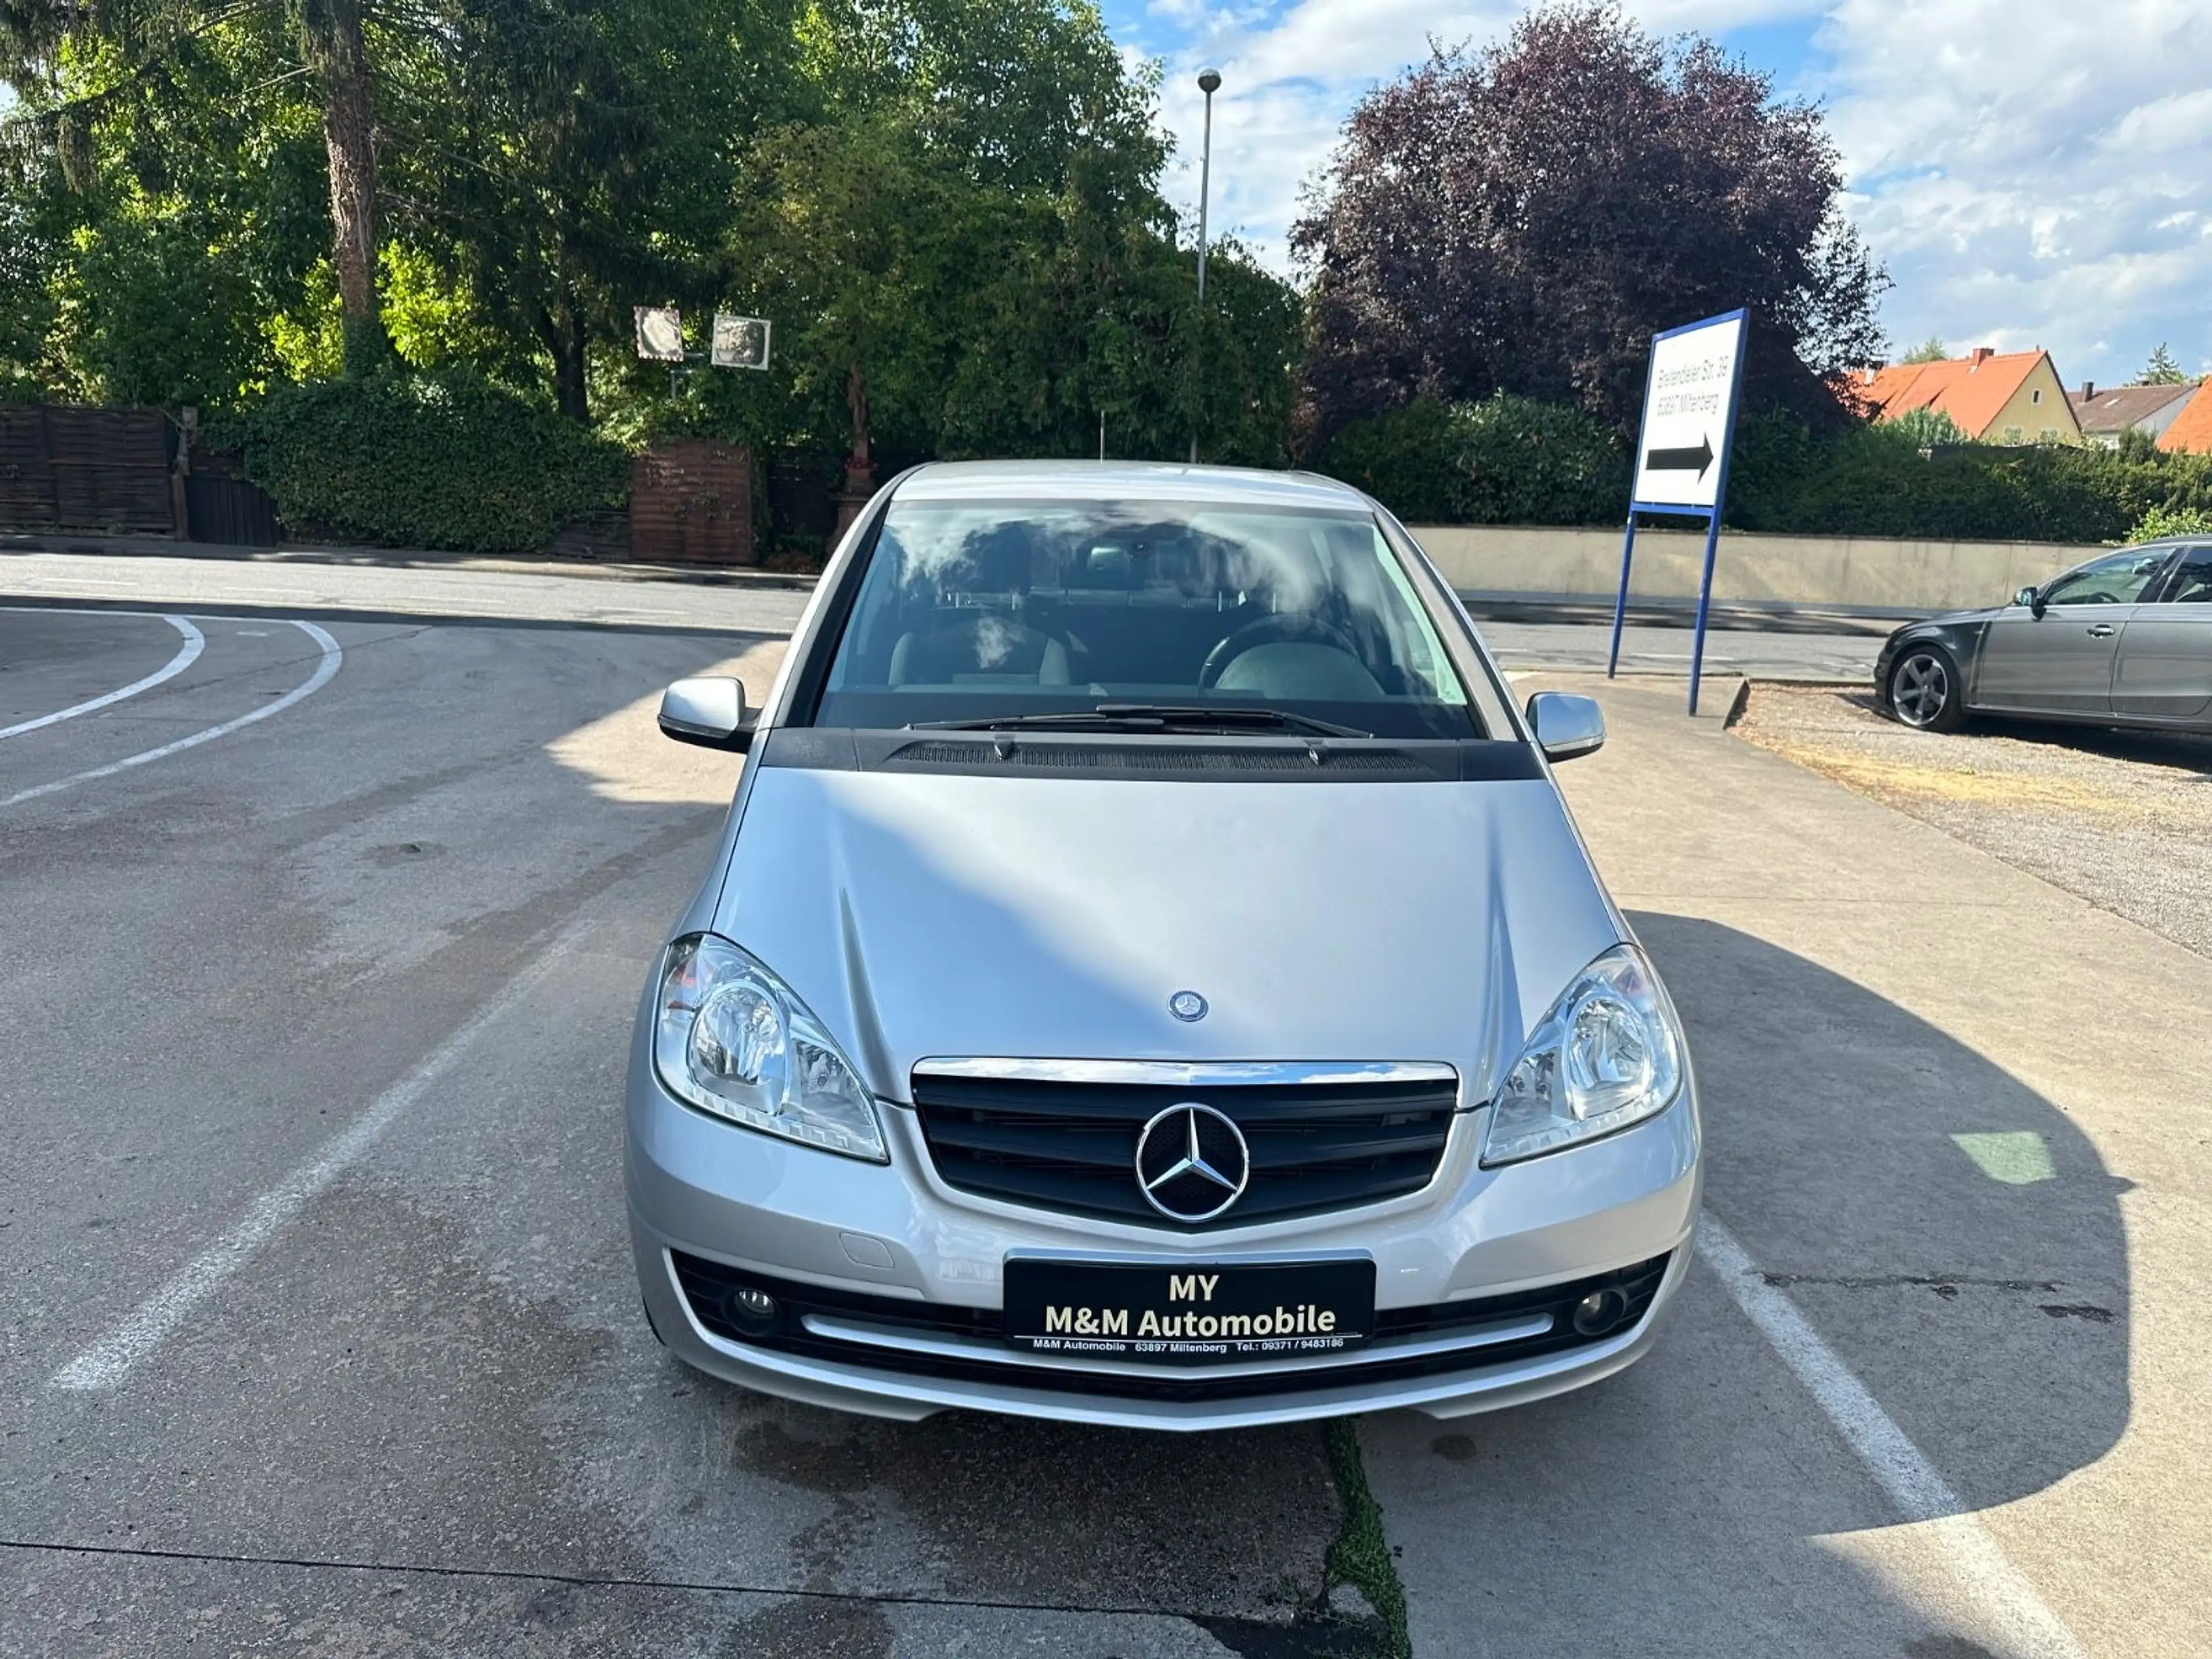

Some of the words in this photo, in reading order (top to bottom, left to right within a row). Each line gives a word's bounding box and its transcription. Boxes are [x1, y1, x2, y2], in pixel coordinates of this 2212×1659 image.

[1169, 1275, 1219, 1301] MY
[1046, 1306, 1128, 1335] M&M
[1138, 1305, 1336, 1337] Automobile
[1033, 1339, 1060, 1349] M&M
[1063, 1340, 1126, 1351] Automobile
[1134, 1342, 1166, 1351] 63897
[1169, 1342, 1227, 1353] Miltenberg
[1262, 1340, 1292, 1350] 09371
